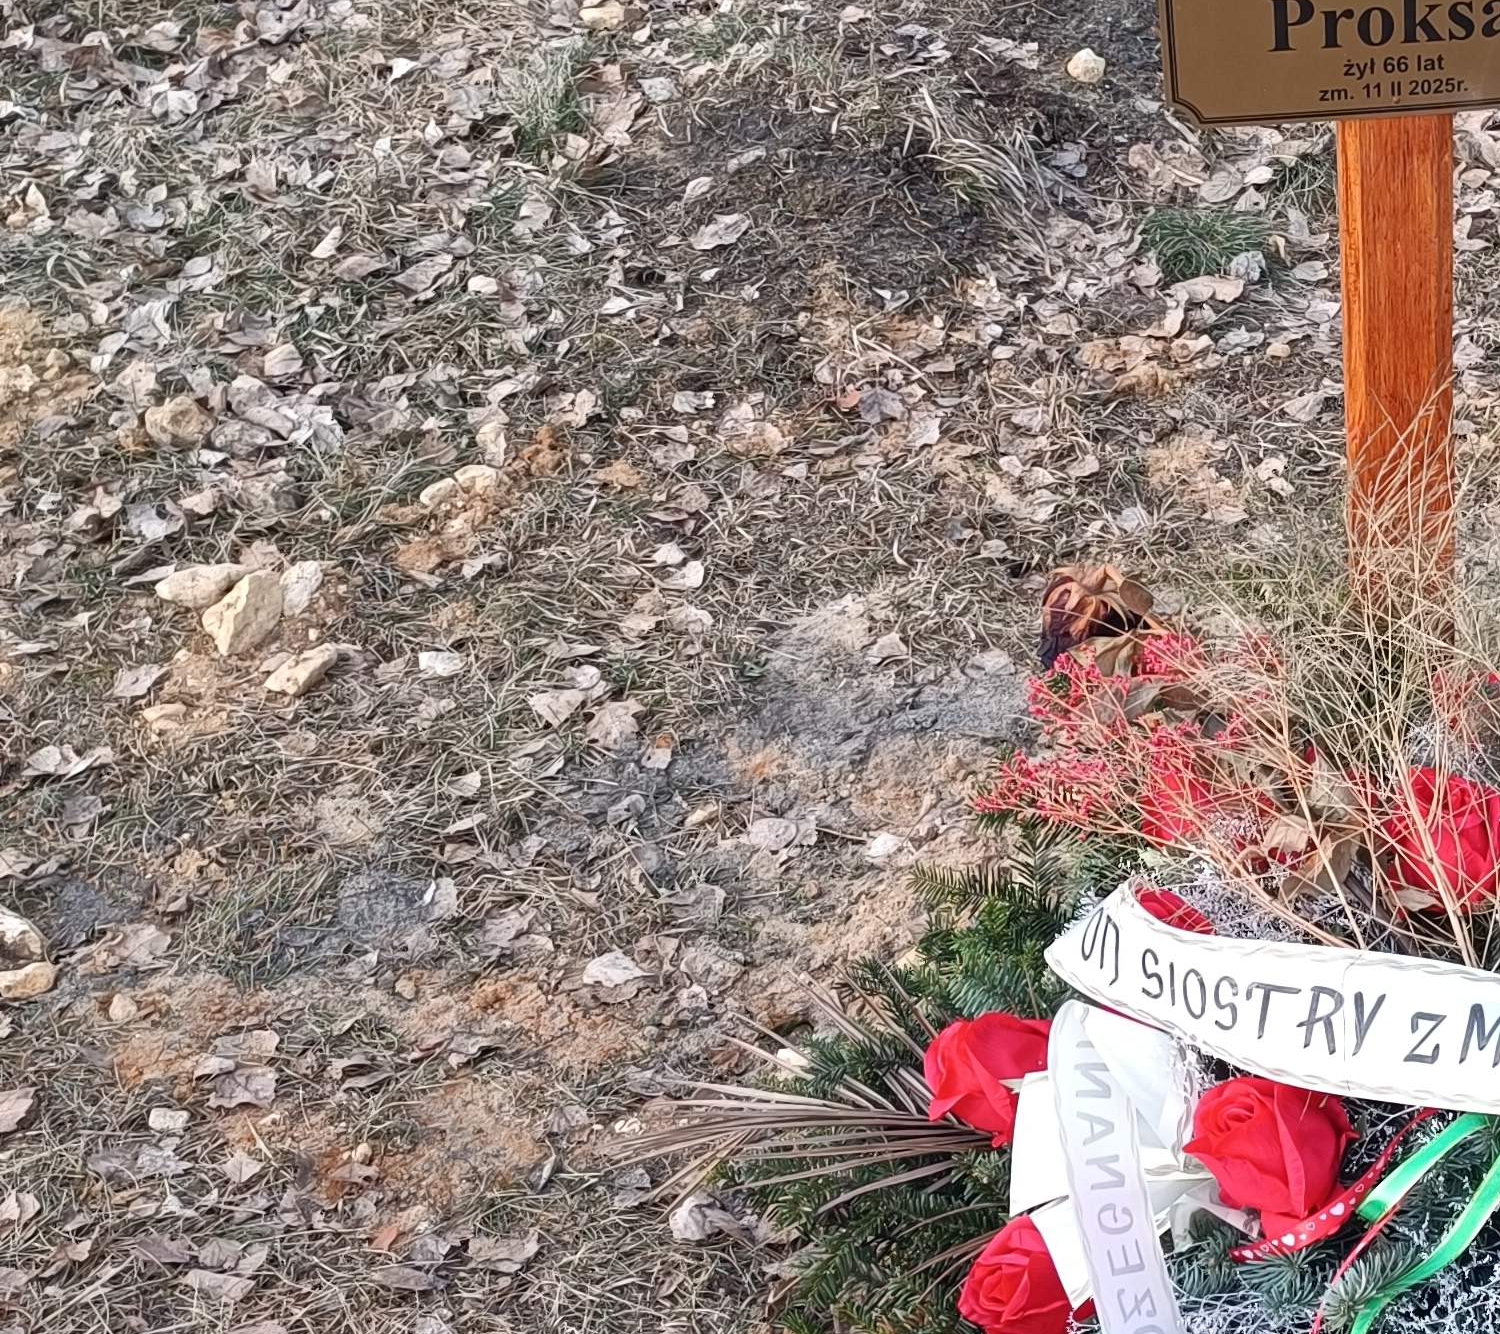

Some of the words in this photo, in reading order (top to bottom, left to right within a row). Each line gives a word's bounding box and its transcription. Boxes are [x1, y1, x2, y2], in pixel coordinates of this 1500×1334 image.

[1343, 57, 1376, 81] żył
[1383, 55, 1409, 74] 66
[1416, 54, 1445, 72] lat
[1318, 88, 1354, 102] zm.
[1362, 82, 1382, 99] 11
[1390, 81, 1401, 97] II
[1408, 77, 1469, 96] 2025r.
[1141, 947, 1387, 1057] SIOSTRY
[1402, 1011, 1448, 1065] Z
